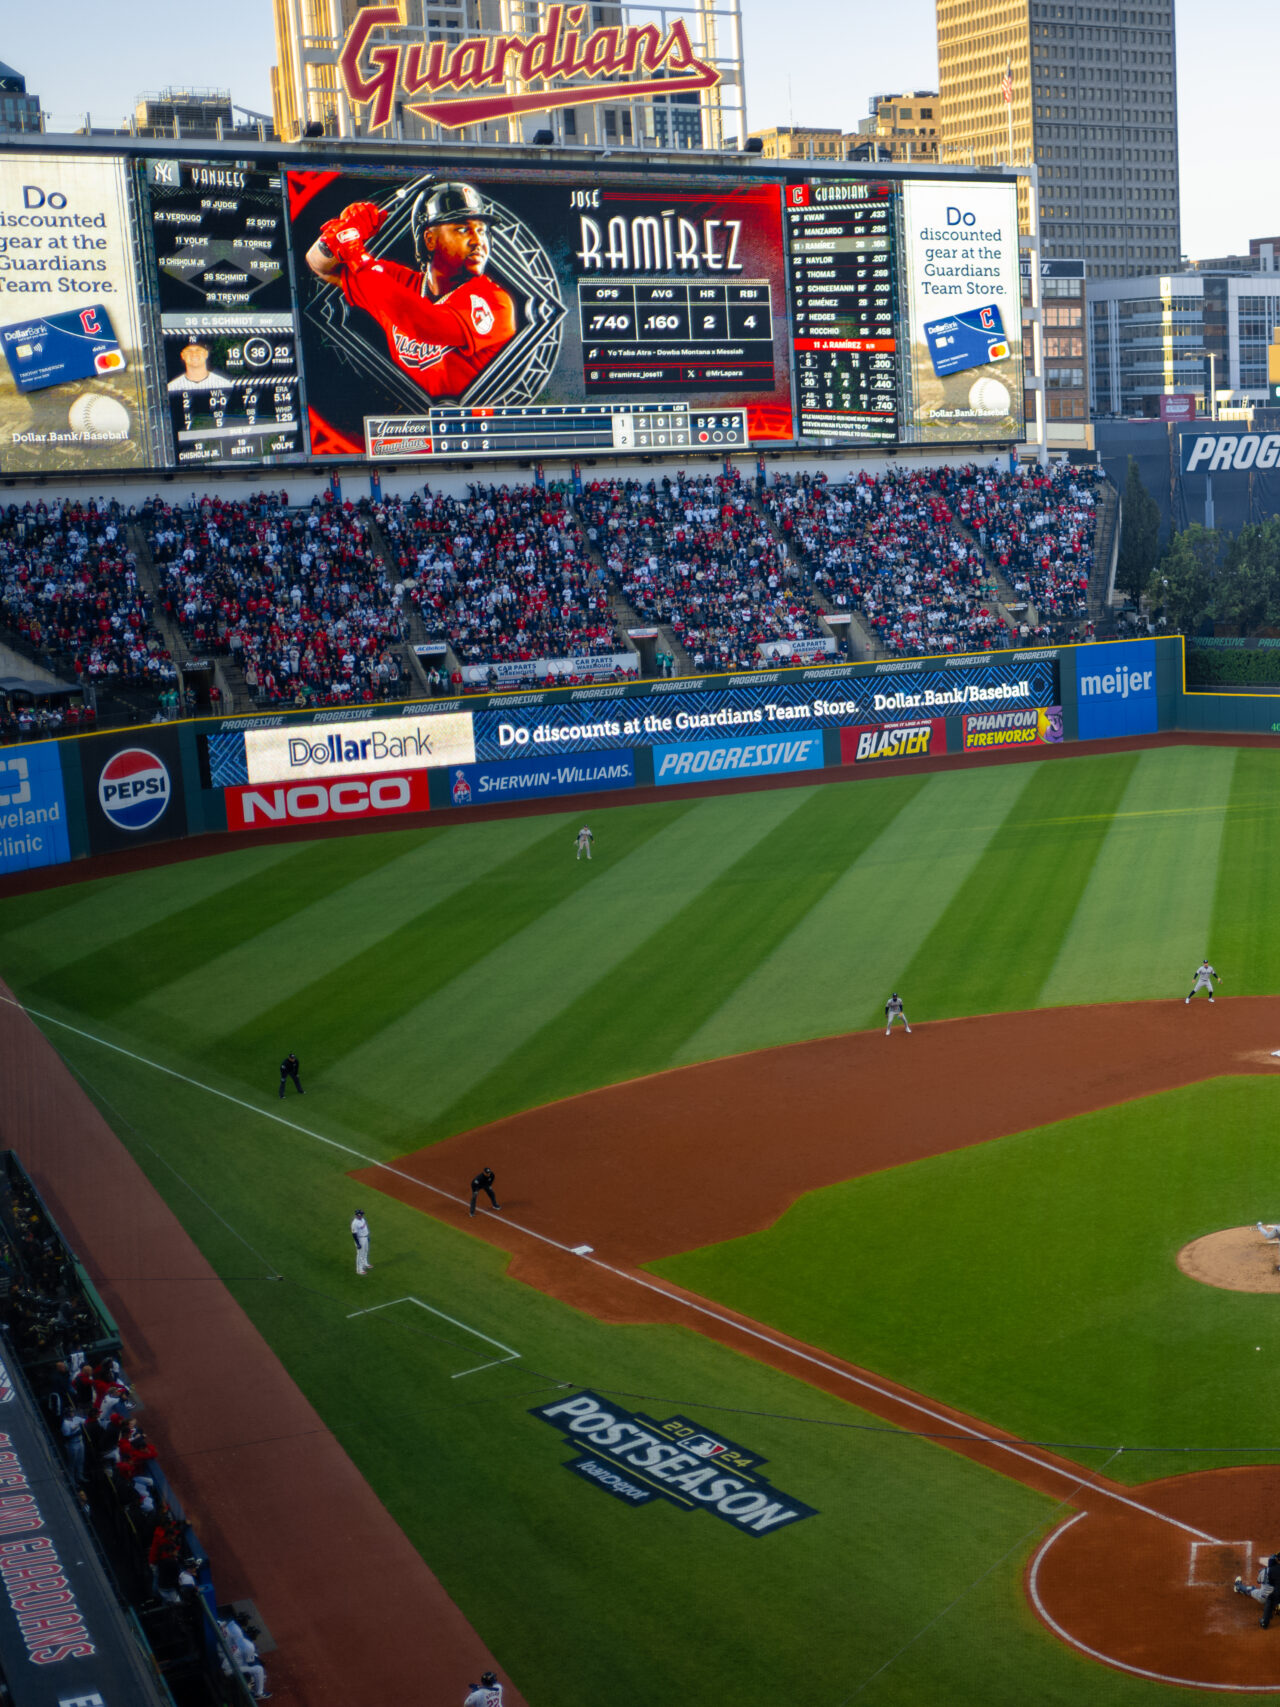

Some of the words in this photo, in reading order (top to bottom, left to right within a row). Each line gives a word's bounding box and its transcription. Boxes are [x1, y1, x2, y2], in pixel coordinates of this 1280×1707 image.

[338, 4, 721, 132] Guardians
[191, 168, 245, 188] YANKEES
[23, 185, 67, 210] Do
[570, 189, 600, 208] JOSÉ
[815, 185, 869, 201] GUARDIANS
[212, 201, 238, 209] JUDGE
[0, 211, 107, 228] iscounted
[154, 212, 164, 220] 24
[166, 213, 202, 222] VERDUGO
[256, 219, 276, 227] SOTO
[946, 206, 976, 226] Do
[184, 237, 208, 245] VOLPE
[576, 209, 743, 270] RAMÍREZ
[920, 228, 1002, 242] discounted
[0, 236, 42, 252] gear
[48, 235, 68, 249] at
[72, 234, 107, 249] the
[233, 240, 242, 248] 25
[244, 240, 272, 248] TORRES
[925, 247, 958, 262] gear
[961, 247, 975, 260] at
[979, 247, 1002, 260] the
[0, 254, 107, 271] Guardians
[166, 258, 196, 266] CHISHOLM
[924, 263, 1000, 277] Guardians
[58, 277, 118, 293] Store.
[922, 282, 963, 294] Team
[966, 282, 1007, 295] Store.
[596, 290, 619, 298] OPS
[651, 290, 673, 298] AVG
[700, 290, 715, 298] HR
[740, 290, 757, 298] RBI
[589, 316, 630, 330] .740
[644, 316, 679, 330] .160
[703, 316, 716, 329] 2
[743, 316, 756, 328] 4
[930, 408, 1009, 418] Dollar.Bank/Baseball
[375, 419, 426, 438] Yankees
[12, 431, 128, 442] Dollar.Bank/Baseball
[946, 656, 992, 666] PROGRESSIVE
[1013, 650, 1058, 661] PROGRESSIVE
[803, 668, 852, 679] PROGRESSIVE
[876, 662, 924, 672] PROGRESSIVE
[651, 680, 704, 692] PROGRESSIVE
[728, 674, 780, 686] PROGRESSIVE
[1081, 666, 1152, 698] meijer
[488, 694, 544, 707] PROGRESSIVE
[572, 687, 626, 700] PROGRESSIVE
[403, 700, 461, 715] PROGRESSIVE
[499, 724, 530, 746] Do
[534, 715, 620, 744] discounts
[624, 717, 641, 734] at
[643, 714, 672, 733] the
[676, 705, 762, 730] Guardians
[765, 704, 810, 721] Team
[813, 699, 860, 718] Store.
[874, 680, 1030, 712] Dollar.Bank/Baseball
[313, 708, 374, 722] PROGRESSIVE
[967, 710, 1038, 732] PHANTOM
[220, 716, 284, 730] PROGRESSIVE
[856, 726, 932, 760] BLASTER
[966, 728, 1038, 747] FIREWORKS
[288, 727, 432, 766] DollarBank
[658, 740, 811, 777] PROGRESSIVE
[104, 776, 166, 801] PEPSI
[242, 778, 411, 824] NOCO
[662, 1421, 694, 1438] 20
[542, 1396, 799, 1532] POSTSEASON
[721, 1451, 752, 1468] 24
[577, 1460, 650, 1500] loanDepot
[0, 1536, 96, 1665] GUARDIANS
